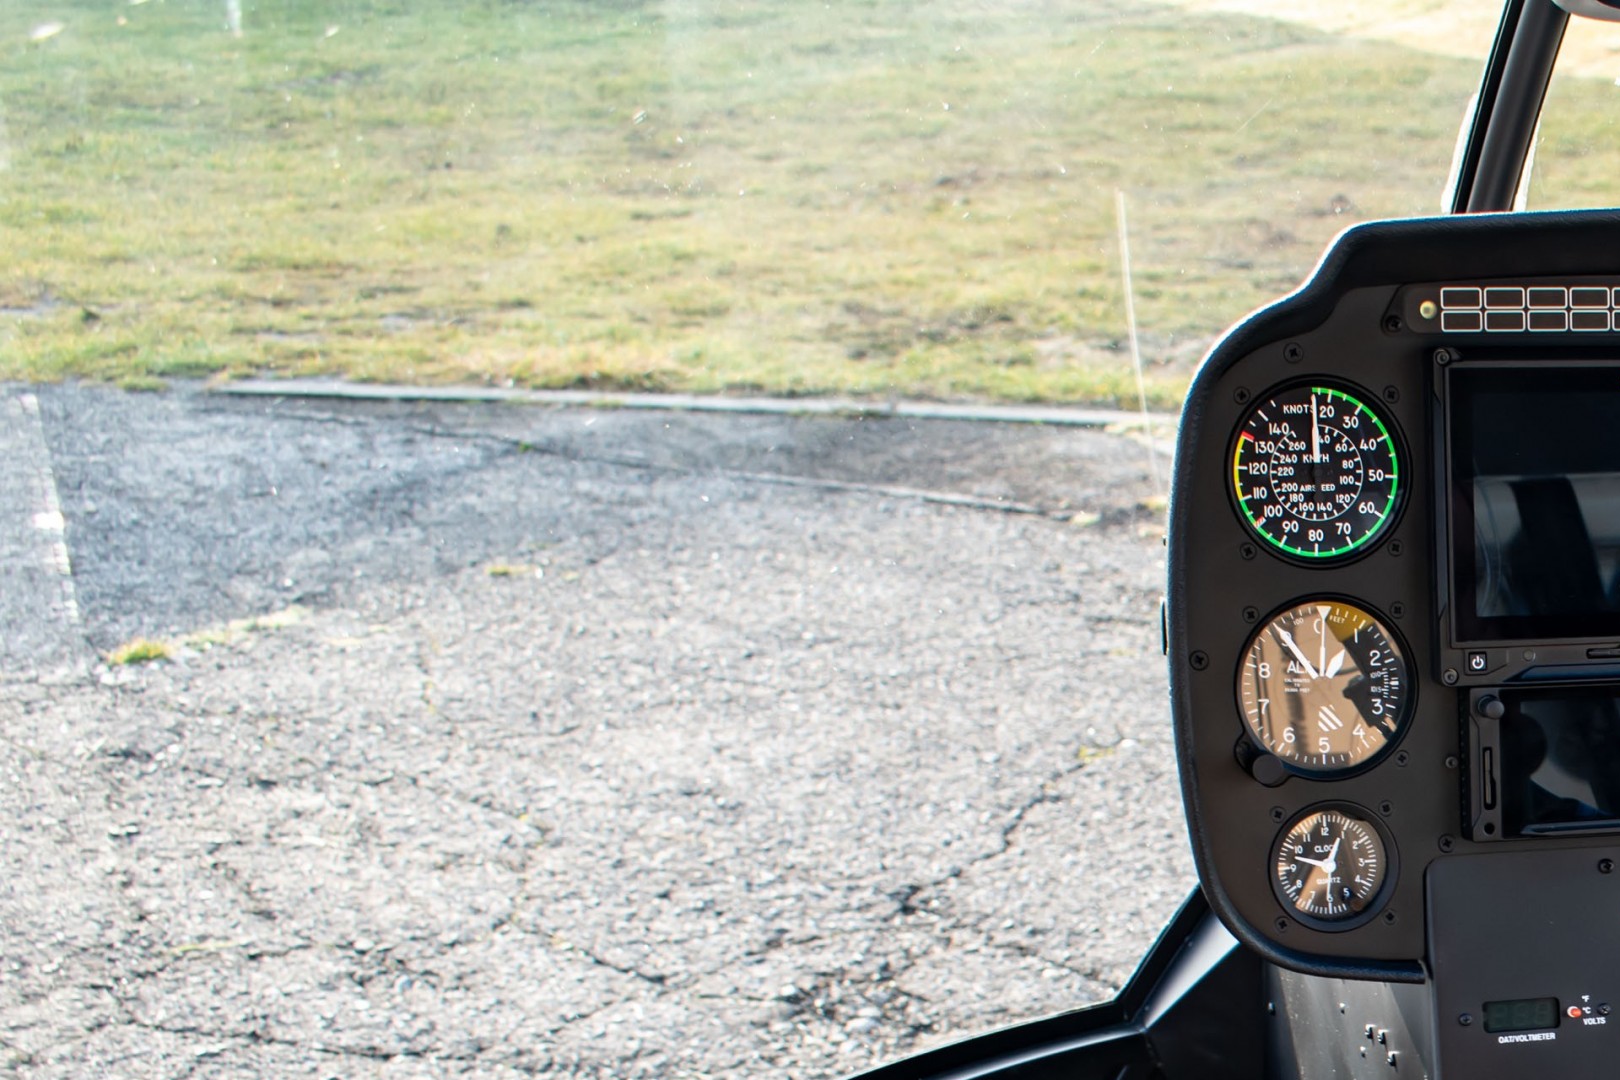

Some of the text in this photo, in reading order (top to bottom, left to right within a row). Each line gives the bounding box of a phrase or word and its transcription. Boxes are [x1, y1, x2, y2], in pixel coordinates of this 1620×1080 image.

[1320, 405, 1334, 417] 20
[1343, 416, 1359, 428] 30
[1269, 423, 1289, 435] 140
[1255, 441, 1274, 454] 130
[1289, 441, 1306, 450] 260
[1360, 439, 1376, 450] 40
[1280, 454, 1297, 463] 240
[1249, 463, 1267, 475] 120
[1277, 467, 1294, 476] 220
[1368, 470, 1383, 481] 50
[1253, 487, 1267, 499] 110
[1300, 484, 1335, 492] AIRSEED
[1264, 505, 1282, 517] 100
[1359, 501, 1374, 513] 60
[1282, 520, 1298, 533] 90
[1336, 522, 1351, 535] 70
[1308, 529, 1323, 541] 80
[1369, 650, 1381, 666] 2
[1259, 663, 1270, 678] 8
[1372, 698, 1383, 715] 3
[1283, 727, 1295, 743] 6
[1318, 737, 1330, 753] 5
[1583, 1017, 1606, 1025] VOLTS
[1498, 1032, 1556, 1044] OAT/VOLTMETER
